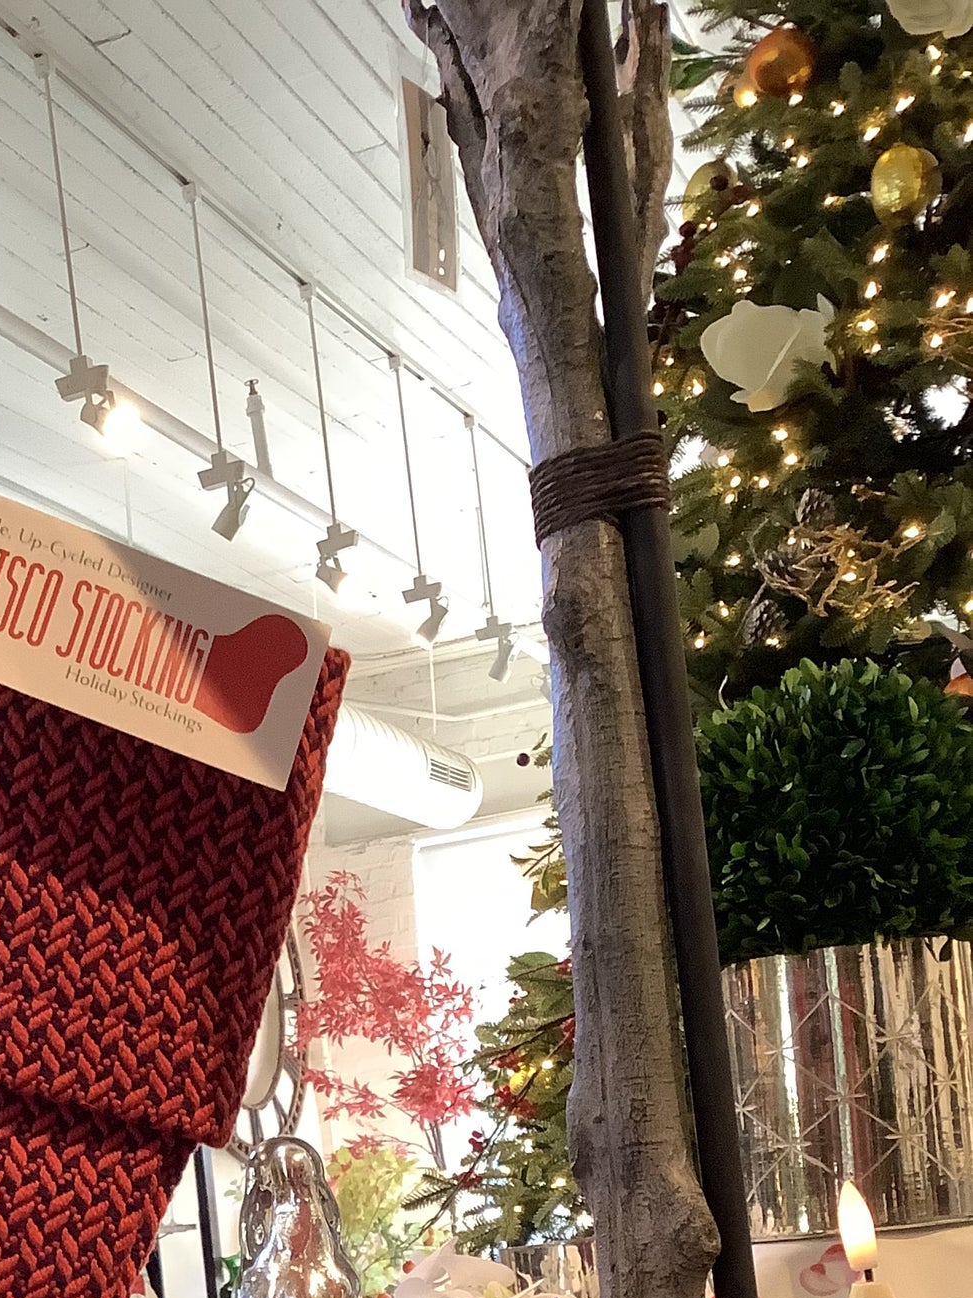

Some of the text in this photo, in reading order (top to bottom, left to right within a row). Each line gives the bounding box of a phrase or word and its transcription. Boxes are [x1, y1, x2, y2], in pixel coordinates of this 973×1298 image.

[19, 528, 104, 572] Up-Cycled
[108, 562, 172, 601] Designer
[56, 580, 208, 704] STOCKING
[65, 664, 203, 733] Holiday Stockings
